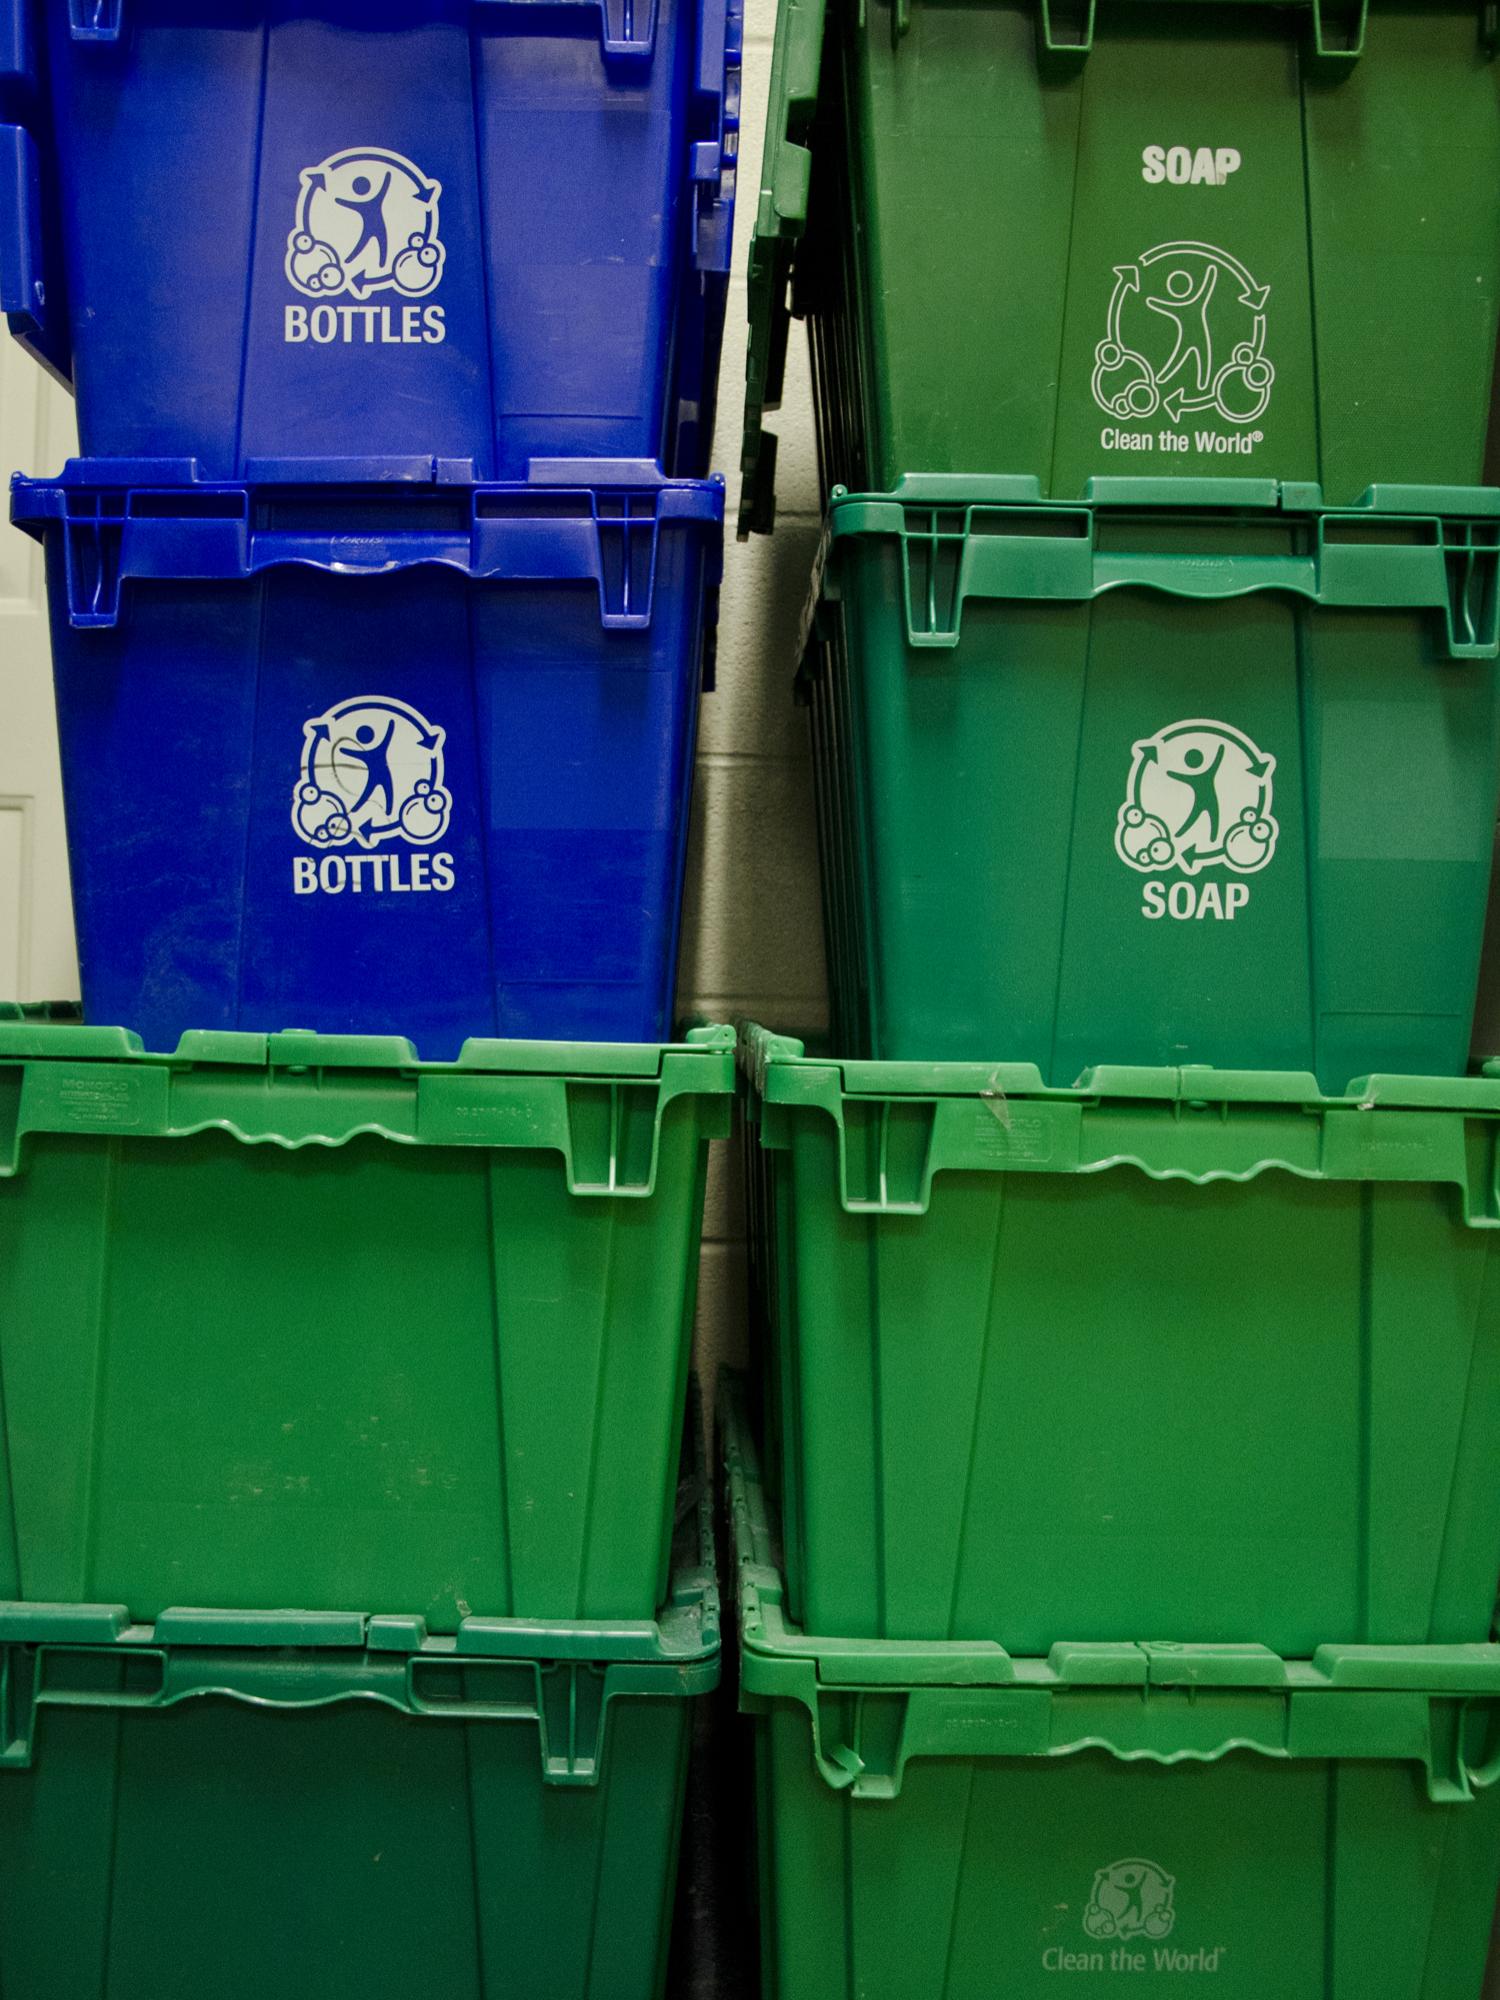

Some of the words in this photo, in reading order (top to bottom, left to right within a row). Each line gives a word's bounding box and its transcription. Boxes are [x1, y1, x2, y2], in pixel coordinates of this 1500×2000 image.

[1142, 145, 1241, 185] SOAP
[284, 305, 446, 344] BOTTLES
[1100, 428, 1153, 451] Clean
[1158, 430, 1189, 452] the
[293, 852, 456, 894] BOTTLES
[1141, 880, 1250, 920] SOAP
[1041, 1947, 1104, 1972] Clean
[1110, 1947, 1147, 1972] the
